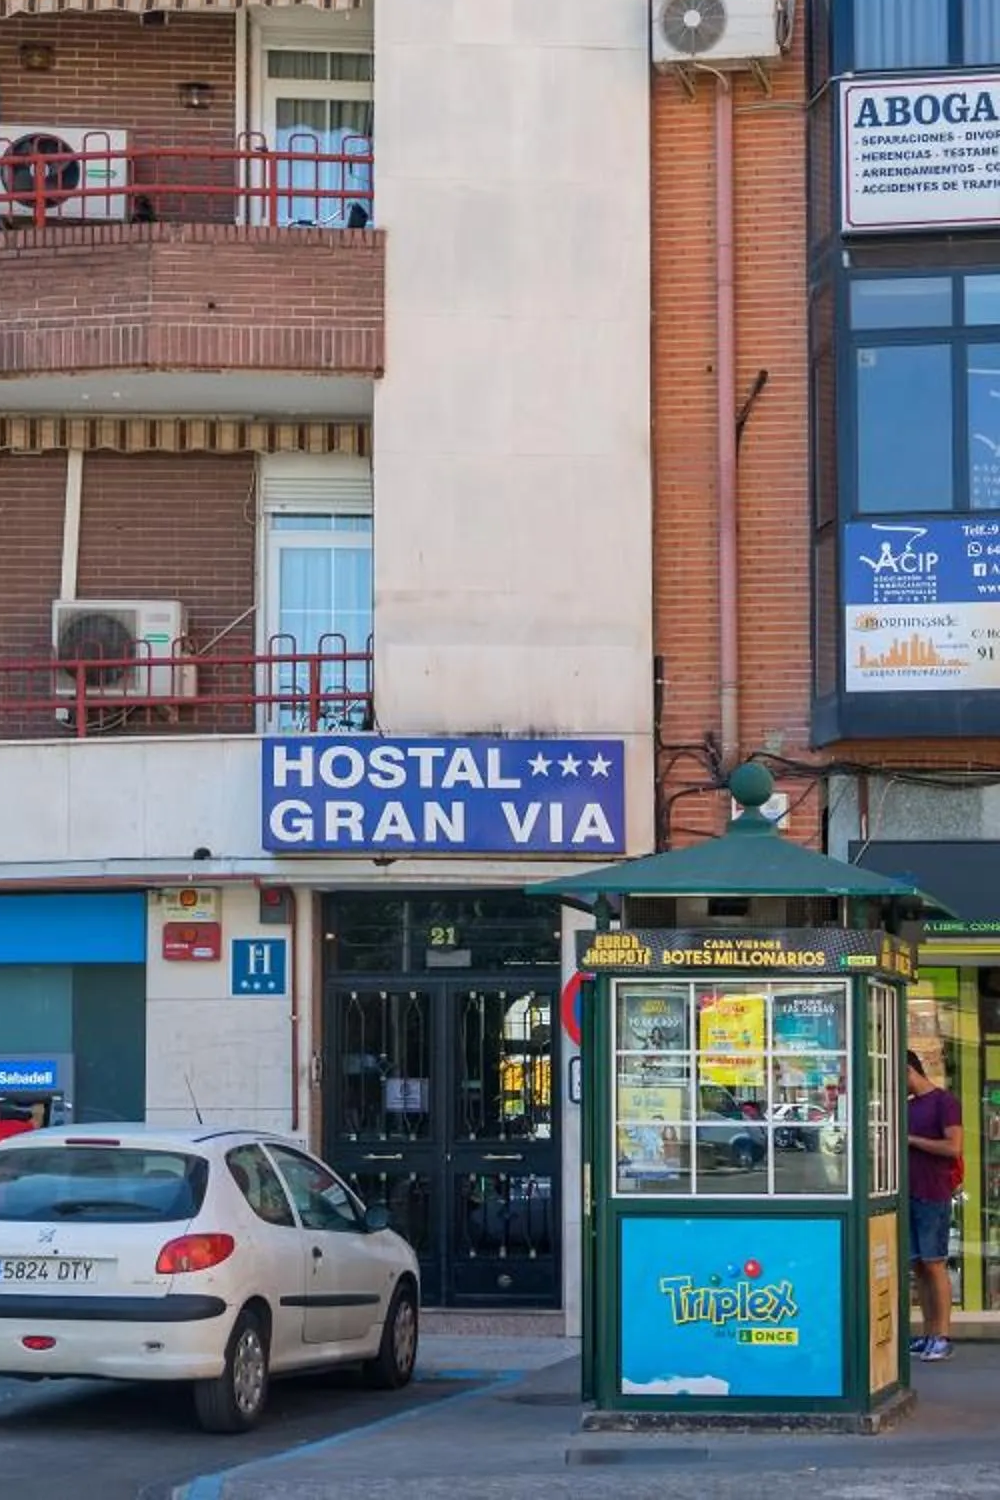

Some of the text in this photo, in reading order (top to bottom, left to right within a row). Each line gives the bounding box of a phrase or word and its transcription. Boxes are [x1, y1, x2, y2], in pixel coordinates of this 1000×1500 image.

[854, 91, 1000, 128] ABOGA
[862, 131, 955, 146] SEPARACIONES
[862, 150, 932, 162] HERENCIAS
[862, 163, 975, 178] ARRENDAMIENTOS
[862, 181, 939, 194] ACCIDENTES
[943, 180, 958, 191] DE
[875, 547, 939, 573] ACIP
[273, 745, 521, 789] HOSTAL
[269, 799, 615, 844] GRAN VIA
[430, 927, 456, 945] 21
[703, 938, 781, 949] CADA VIERNES
[662, 950, 825, 966] BOTES MILLONARIOS
[3, 1261, 94, 1280] 5824 DTY
[660, 1275, 798, 1325] Triplex
[755, 1331, 794, 1341] ONCE
